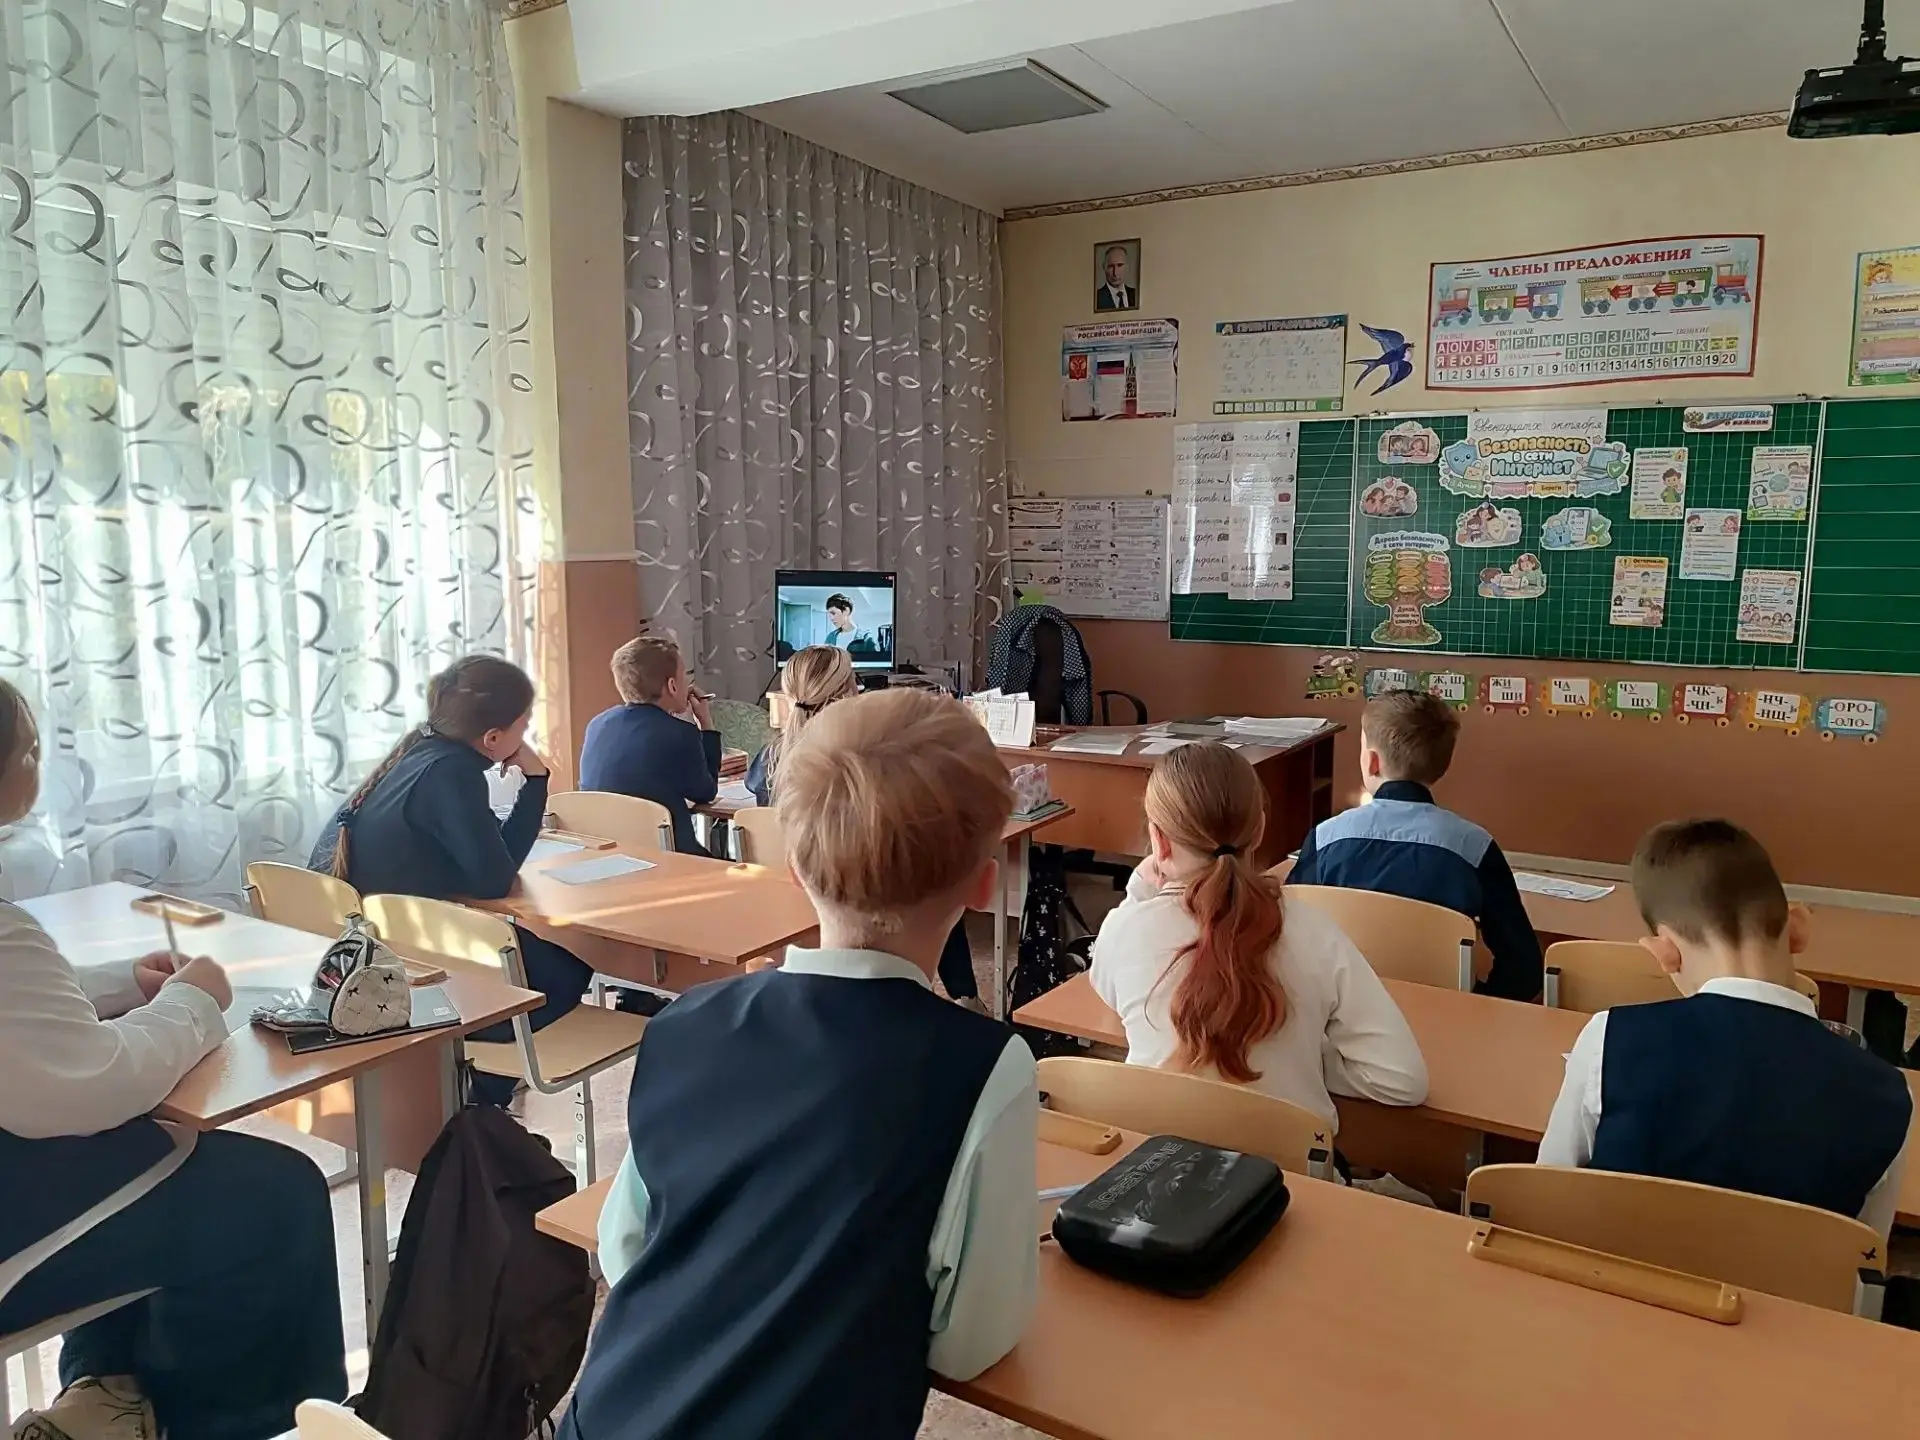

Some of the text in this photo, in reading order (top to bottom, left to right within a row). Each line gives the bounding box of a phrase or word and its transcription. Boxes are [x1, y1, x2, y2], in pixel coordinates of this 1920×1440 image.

[1488, 262, 1549, 278] ЧЛЕНЫ
[1554, 247, 1692, 272] ПРЕДЛОЖЕНИЯ
[1077, 326, 1162, 339] РОССИЙСКОЙ ФЕДЕРАЦИИ
[1564, 363, 1576, 373] 10
[1580, 362, 1590, 372] 11
[1594, 361, 1606, 371] 12
[1610, 360, 1622, 370] 13
[1625, 359, 1637, 369] 14
[1640, 358, 1653, 368] 15
[1655, 357, 1669, 367] 16
[1673, 356, 1686, 366] 17
[1689, 355, 1702, 365] 18
[1705, 354, 1719, 365] 19
[1722, 353, 1736, 364] 20
[1706, 410, 1771, 420] РАЗГОВОРЫ
[1551, 416, 1603, 434] октября
[1478, 436, 1591, 458] Безопасность
[1513, 451, 1554, 461] в сети
[1490, 458, 1575, 478] Интернет
[1491, 678, 1512, 688] ЖИ
[1554, 680, 1571, 690] ЧА
[1619, 684, 1637, 694] ЧУ
[1687, 685, 1716, 696] -ЧК-
[1502, 692, 1523, 701] ШИ
[1564, 694, 1586, 705] ЩА
[1757, 694, 1789, 706] -НЧ-
[1631, 697, 1654, 708] ЩУ
[1685, 699, 1715, 711] -ЧН-
[1830, 702, 1873, 713] -ОРО-
[1830, 716, 1870, 728] -ОЛО-
